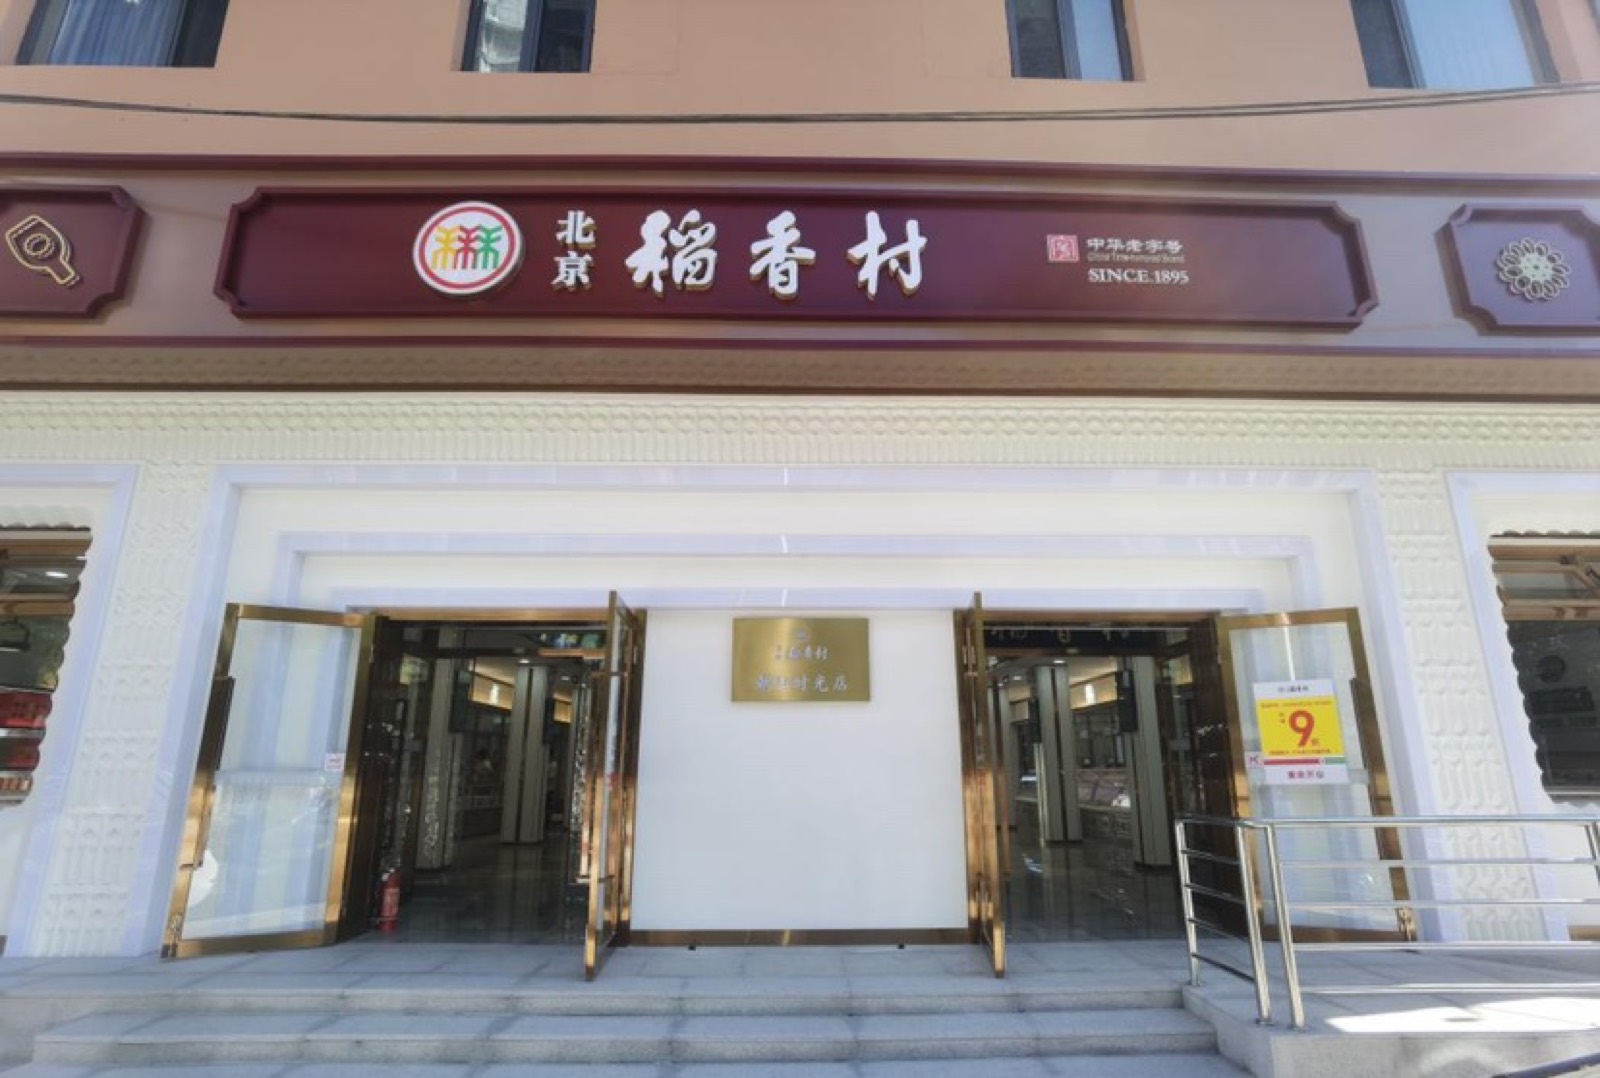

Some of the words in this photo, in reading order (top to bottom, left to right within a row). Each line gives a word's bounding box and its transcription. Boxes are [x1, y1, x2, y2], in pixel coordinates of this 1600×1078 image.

[551, 209, 596, 291] 北京
[625, 209, 928, 299] 稻香村
